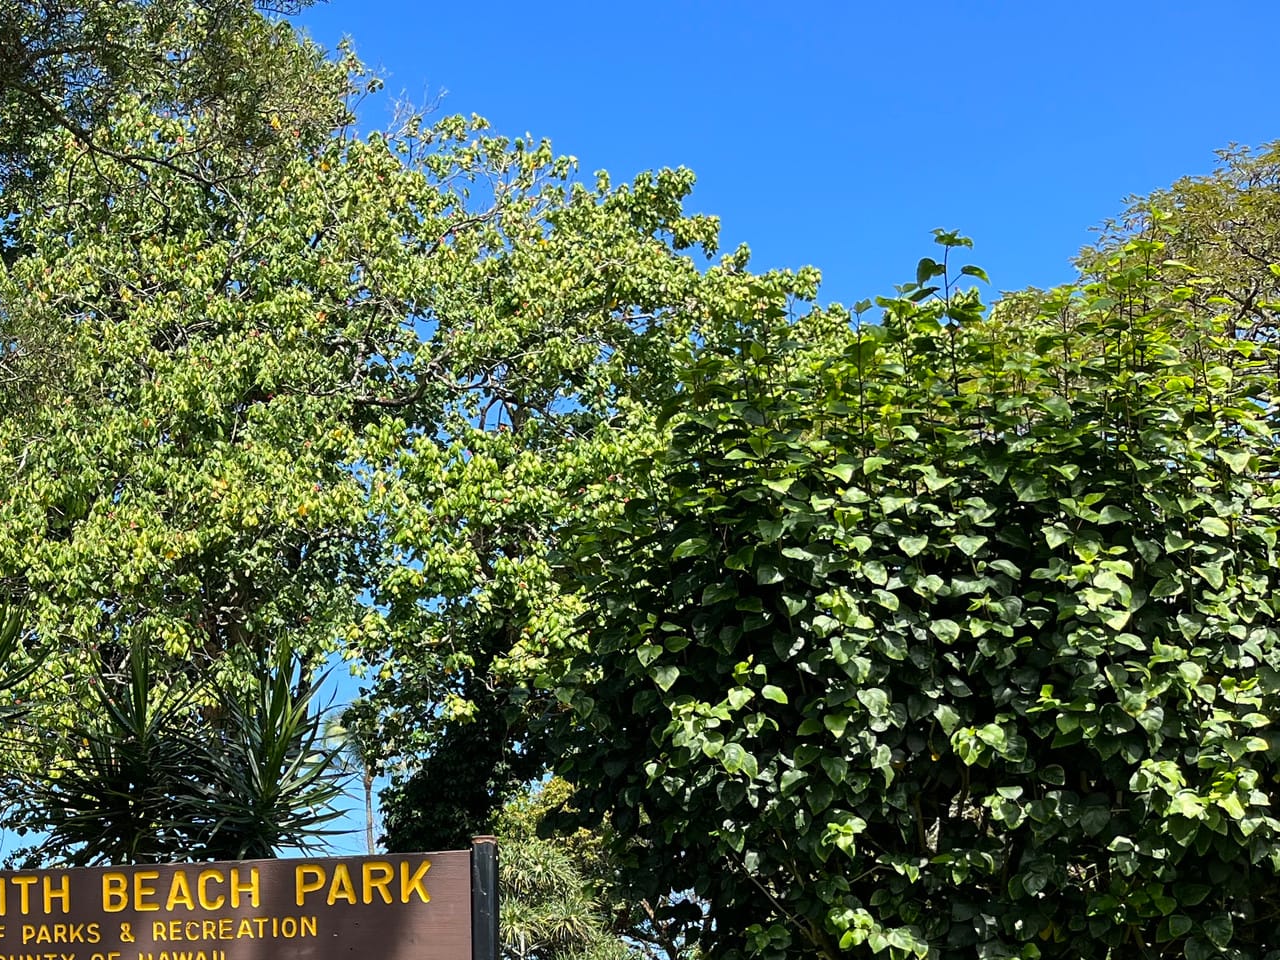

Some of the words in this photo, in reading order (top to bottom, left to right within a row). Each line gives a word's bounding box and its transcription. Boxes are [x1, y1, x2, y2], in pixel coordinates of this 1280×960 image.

[101, 869, 262, 913] BEACH
[295, 860, 433, 907] PARK
[22, 922, 101, 944] PARKS
[119, 922, 136, 943] &
[151, 916, 318, 943] RECREATION
